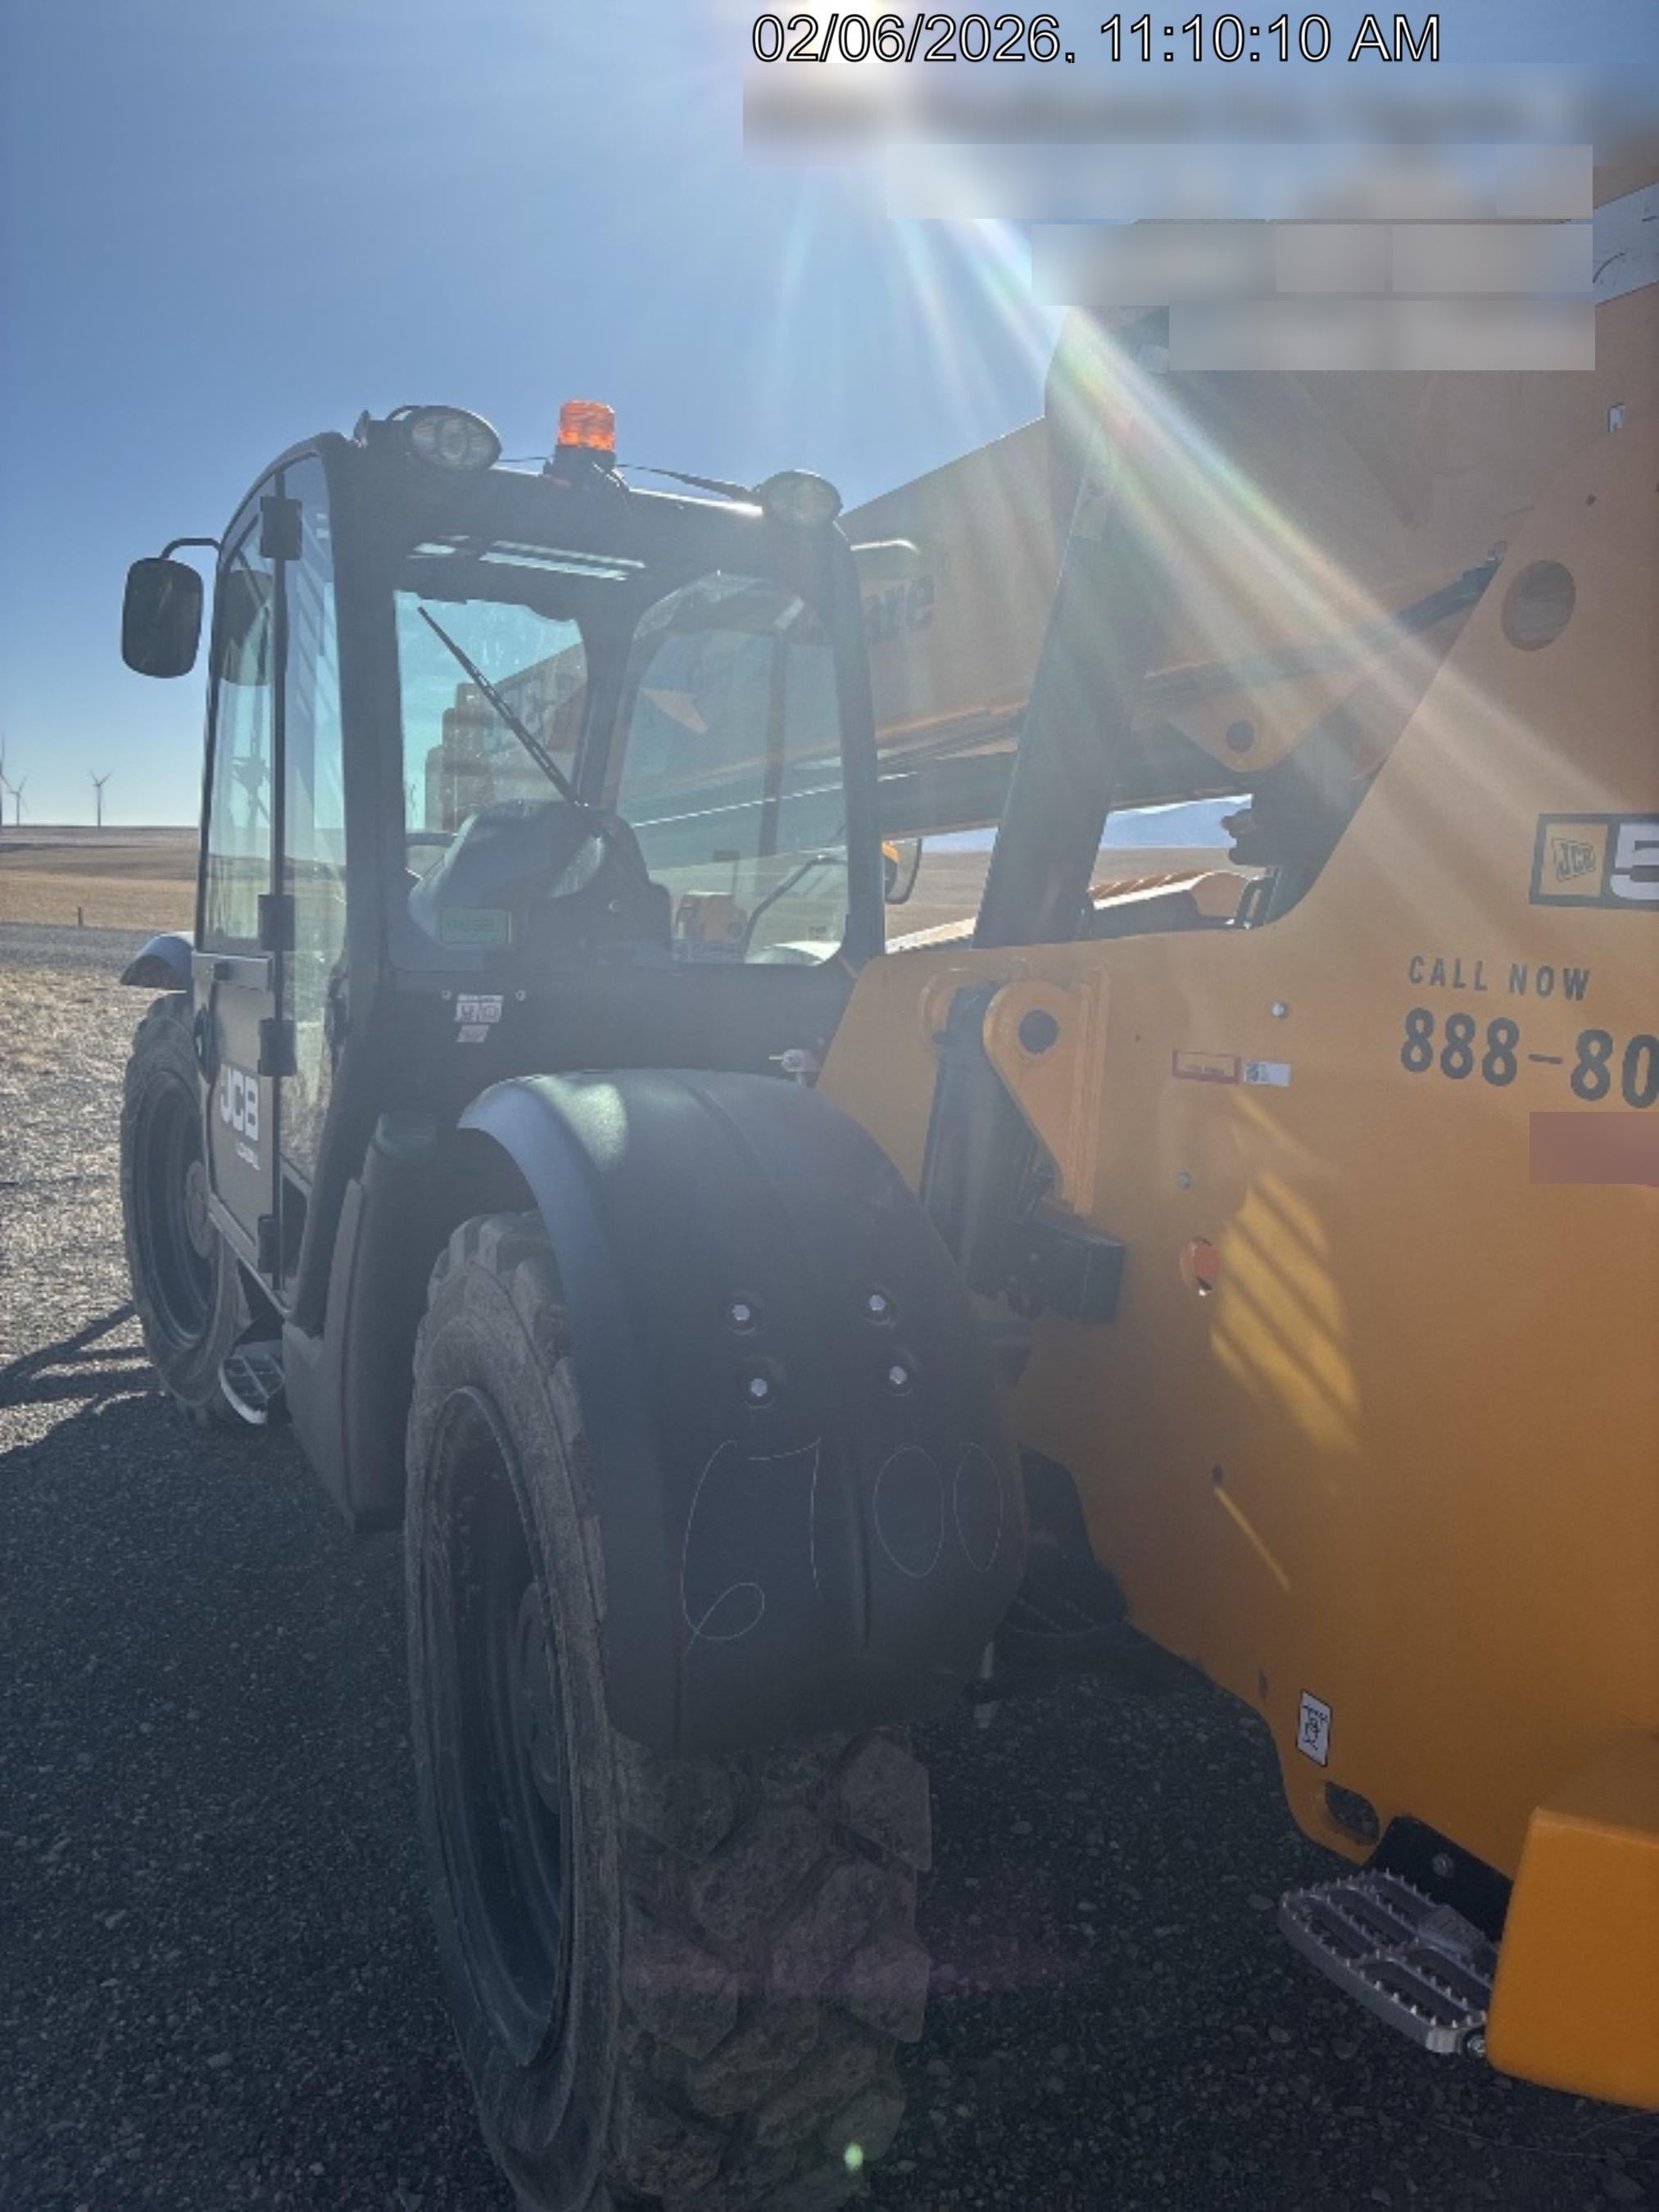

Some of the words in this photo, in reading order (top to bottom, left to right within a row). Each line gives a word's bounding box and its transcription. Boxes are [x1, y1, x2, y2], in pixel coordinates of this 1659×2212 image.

[1555, 841, 1596, 877] JCB
[1408, 955, 1488, 990] CALL
[1508, 963, 1590, 1000] NOW
[1400, 1007, 1659, 1108] 888-80
[220, 1063, 259, 1141] JCB
